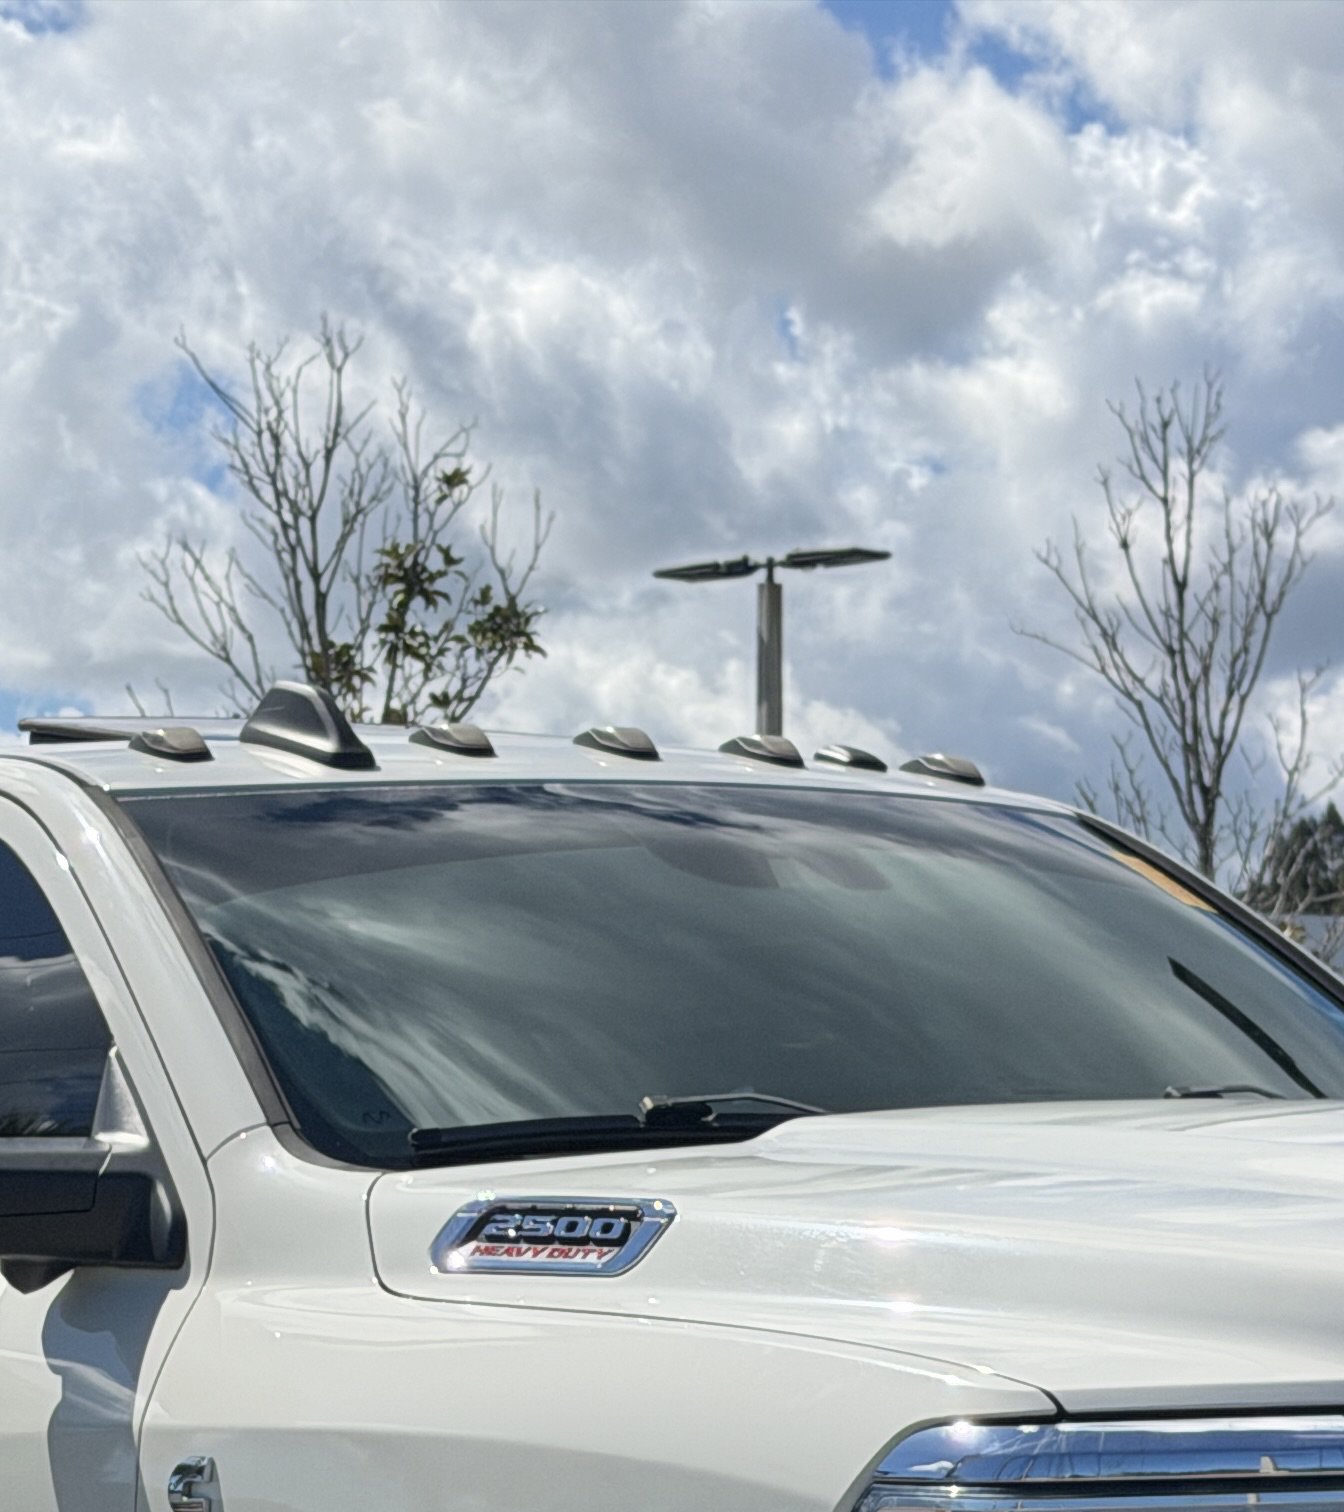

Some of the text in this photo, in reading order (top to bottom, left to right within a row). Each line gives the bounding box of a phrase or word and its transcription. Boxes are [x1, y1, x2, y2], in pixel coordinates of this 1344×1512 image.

[484, 1214, 627, 1241] 2500
[470, 1245, 614, 1261] HEAVY DUTY
